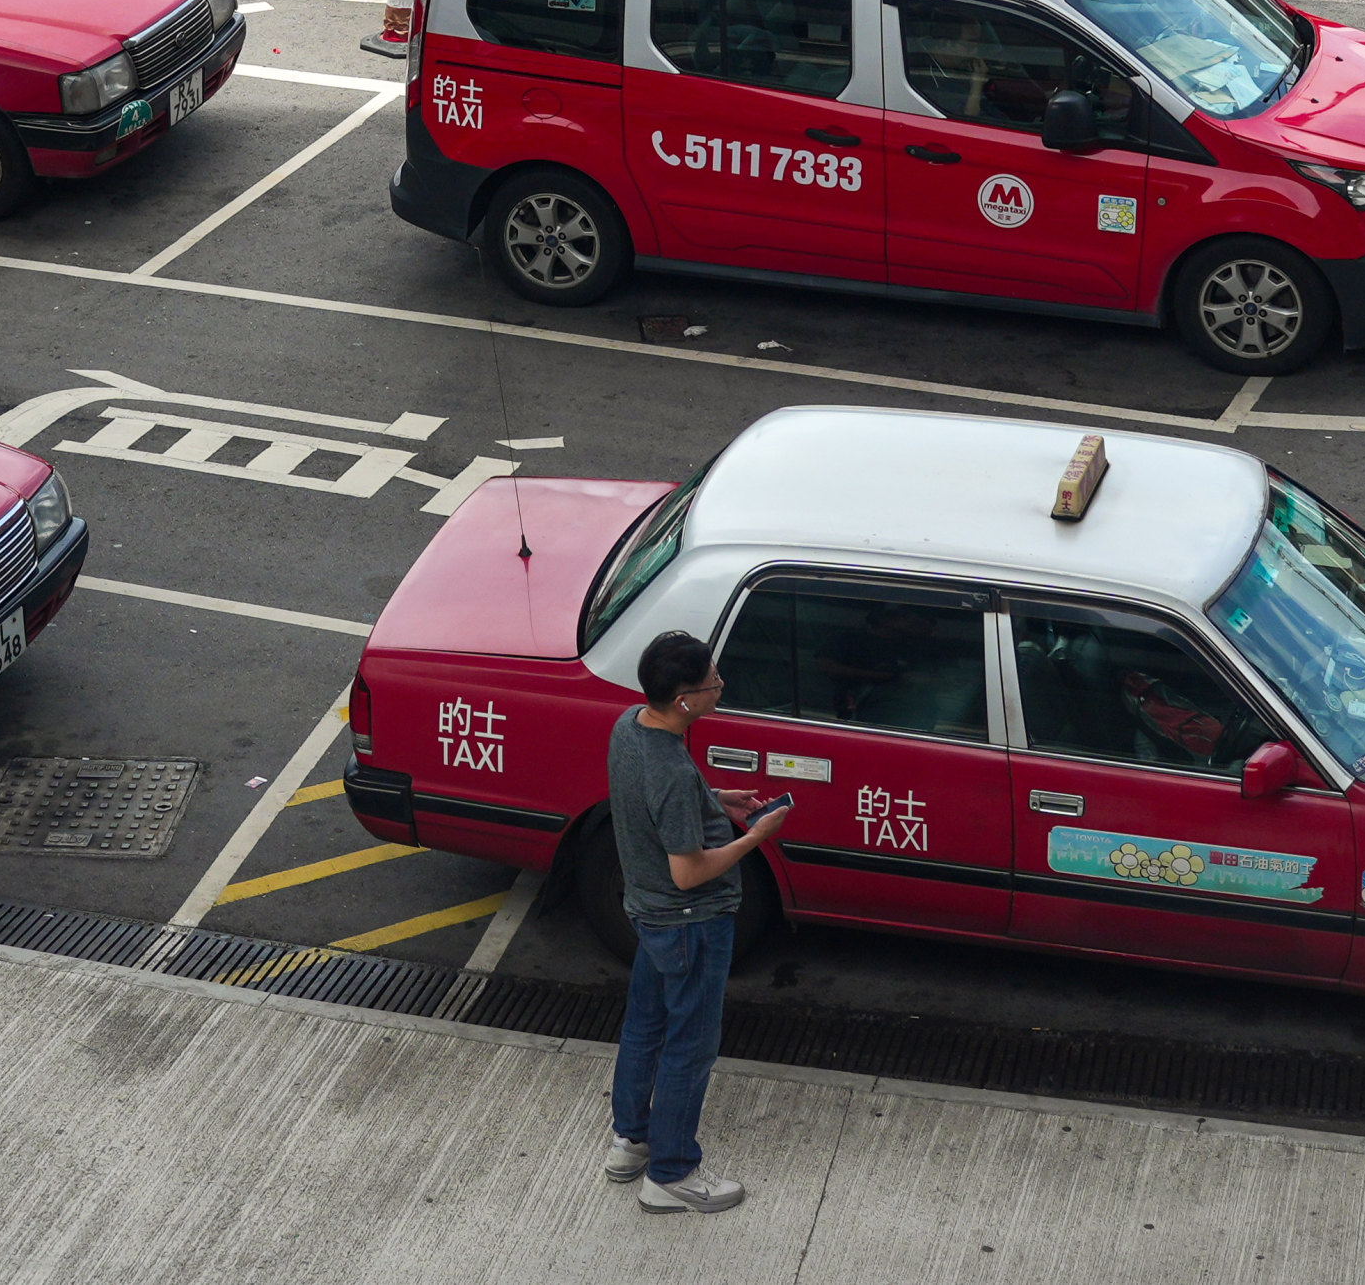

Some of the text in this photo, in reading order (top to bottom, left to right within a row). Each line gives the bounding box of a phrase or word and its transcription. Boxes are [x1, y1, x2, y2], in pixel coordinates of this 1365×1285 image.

[177, 76, 194, 101] RZ
[433, 75, 483, 104] 的士
[132, 110, 139, 122] 4
[175, 90, 201, 121] 7931
[433, 98, 483, 130] TAXI
[684, 133, 863, 192] 5111 7333
[984, 203, 1026, 215] mega taxi
[988, 184, 1023, 208] M
[1061, 489, 1072, 511] 的士
[440, 696, 506, 740] 的士
[438, 737, 504, 773] TAXI
[857, 785, 926, 821] 的士
[856, 816, 928, 851] TAXI
[1075, 833, 1112, 844] TOYOTA
[1209, 849, 1315, 875] 豐田石油氣的士
